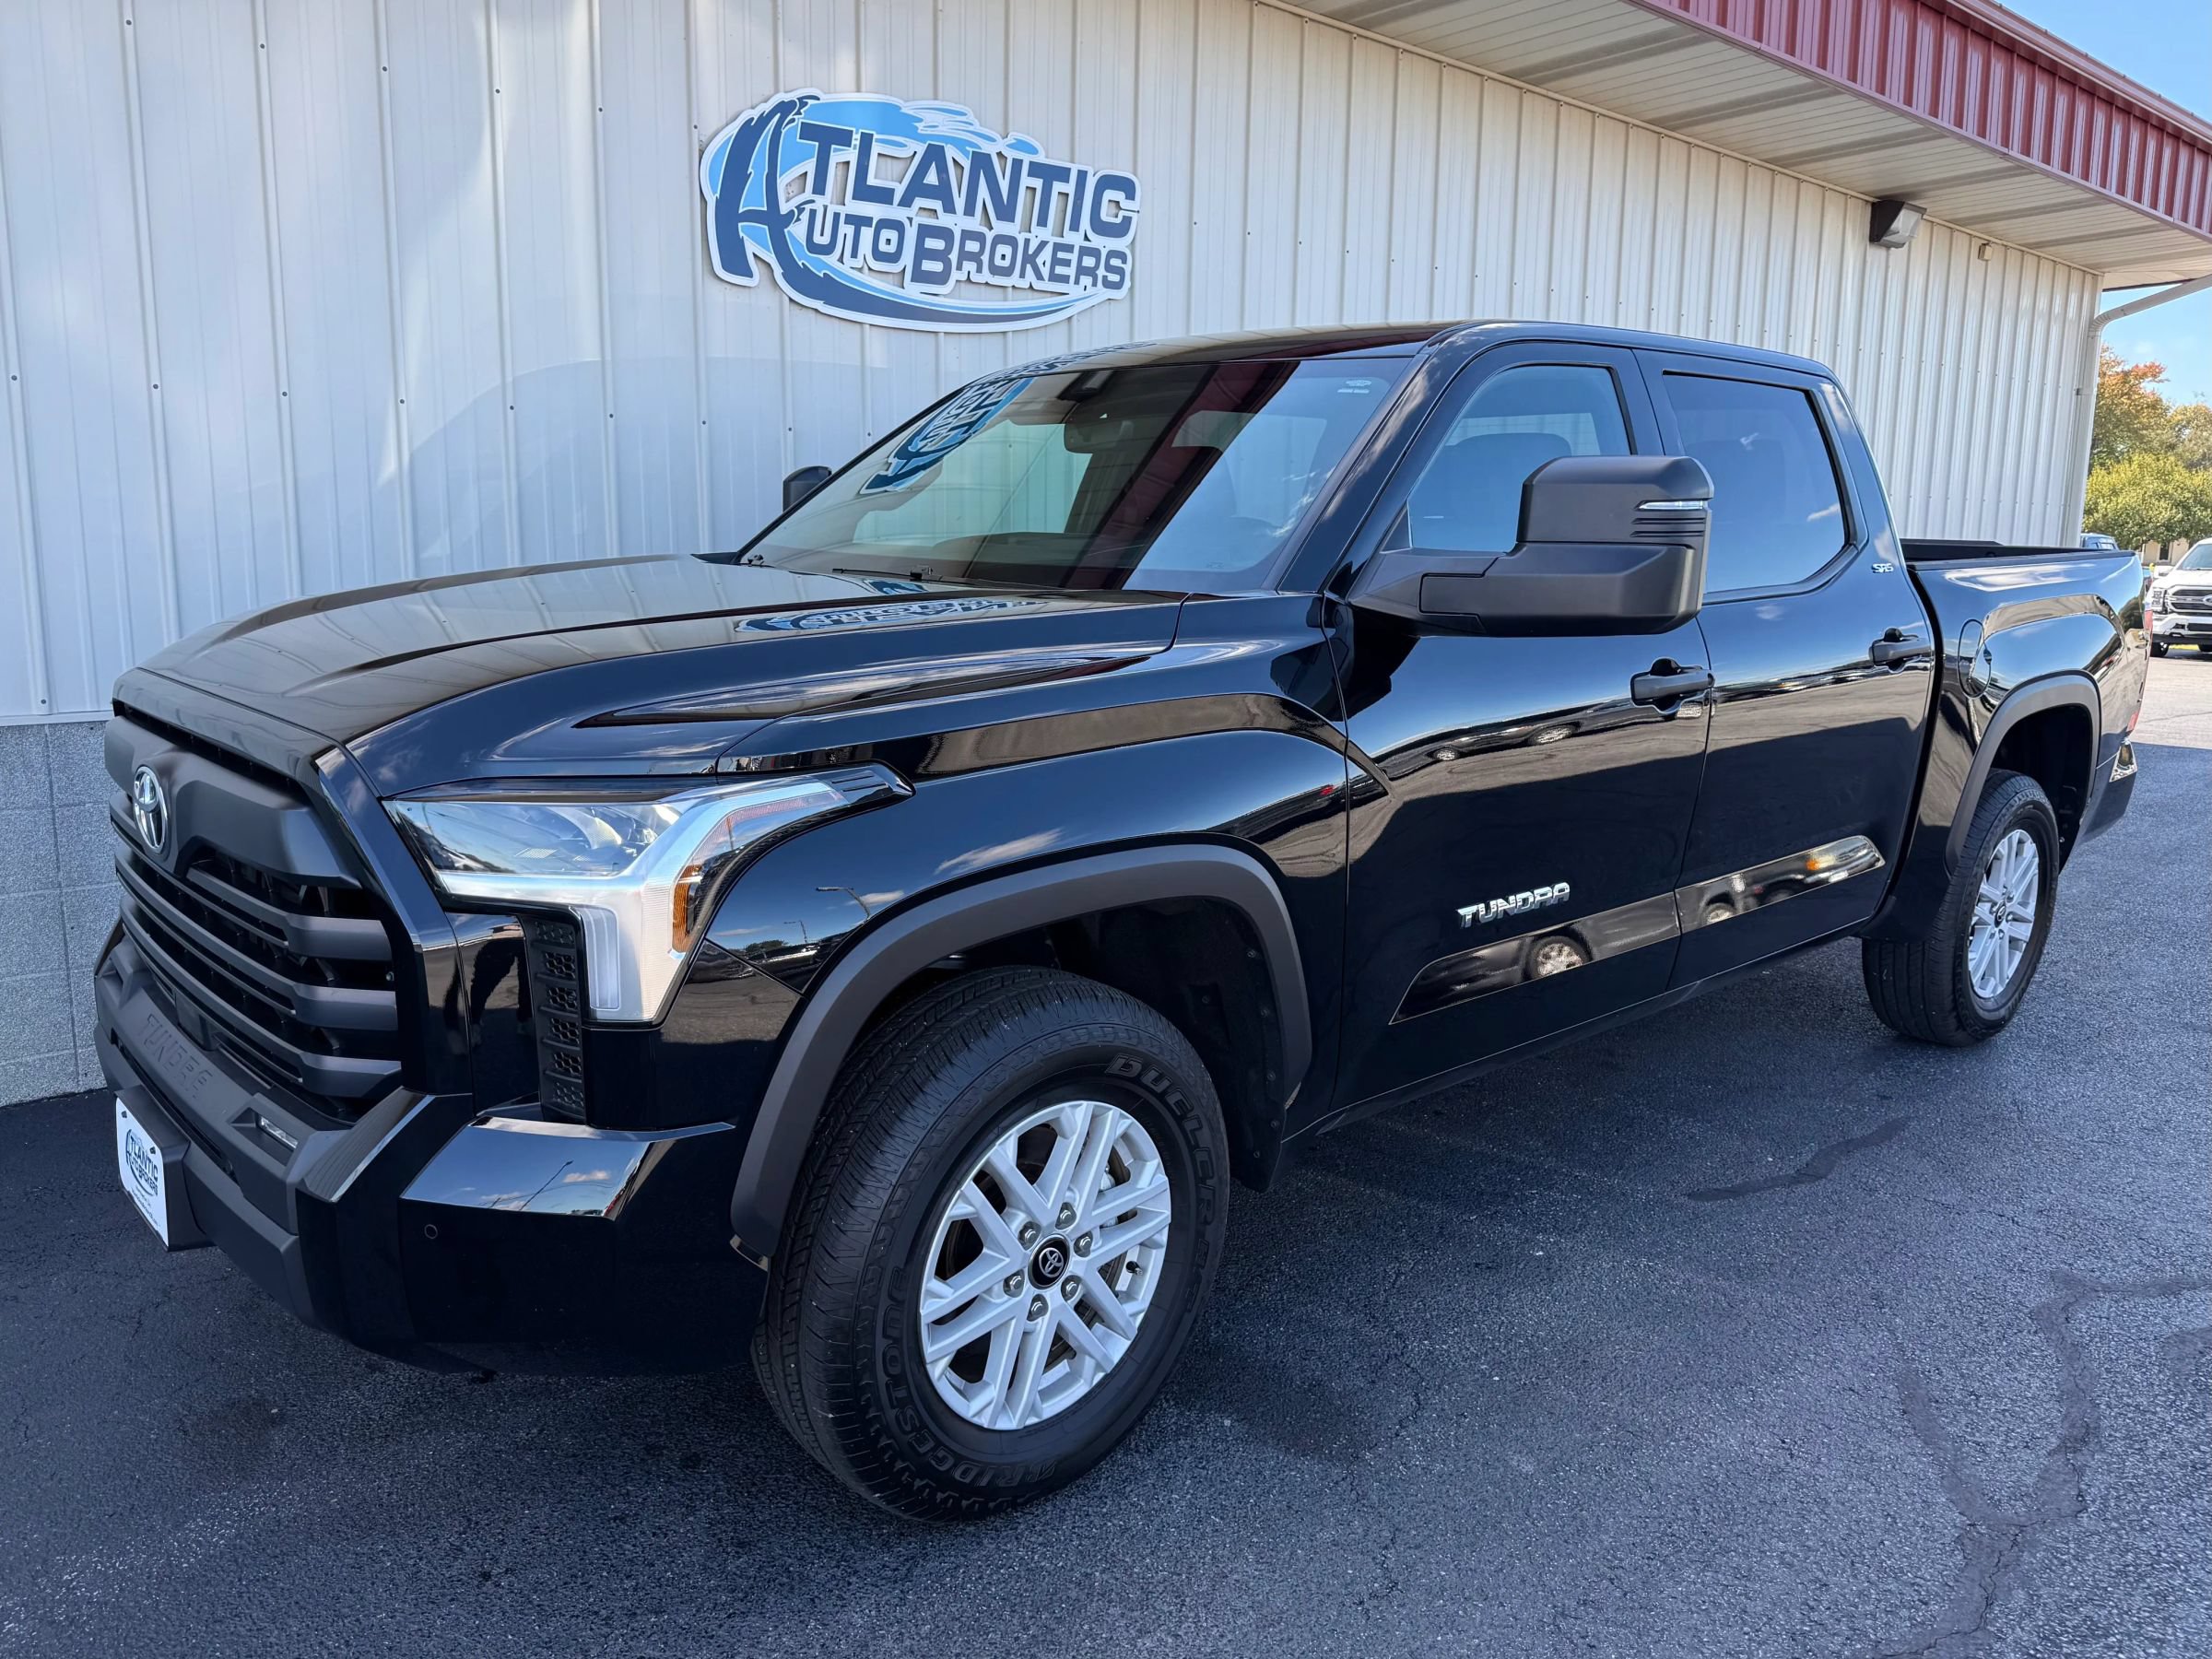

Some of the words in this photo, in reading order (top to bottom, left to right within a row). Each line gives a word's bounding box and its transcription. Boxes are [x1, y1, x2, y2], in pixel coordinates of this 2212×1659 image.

[715, 96, 1136, 278] ATLANTIC
[909, 221, 1128, 291] BROKERS
[1456, 882, 1571, 929] TUNDRA
[1103, 1053, 1217, 1226] DUELER
[882, 1266, 1058, 1488] BRIDGESTONE
